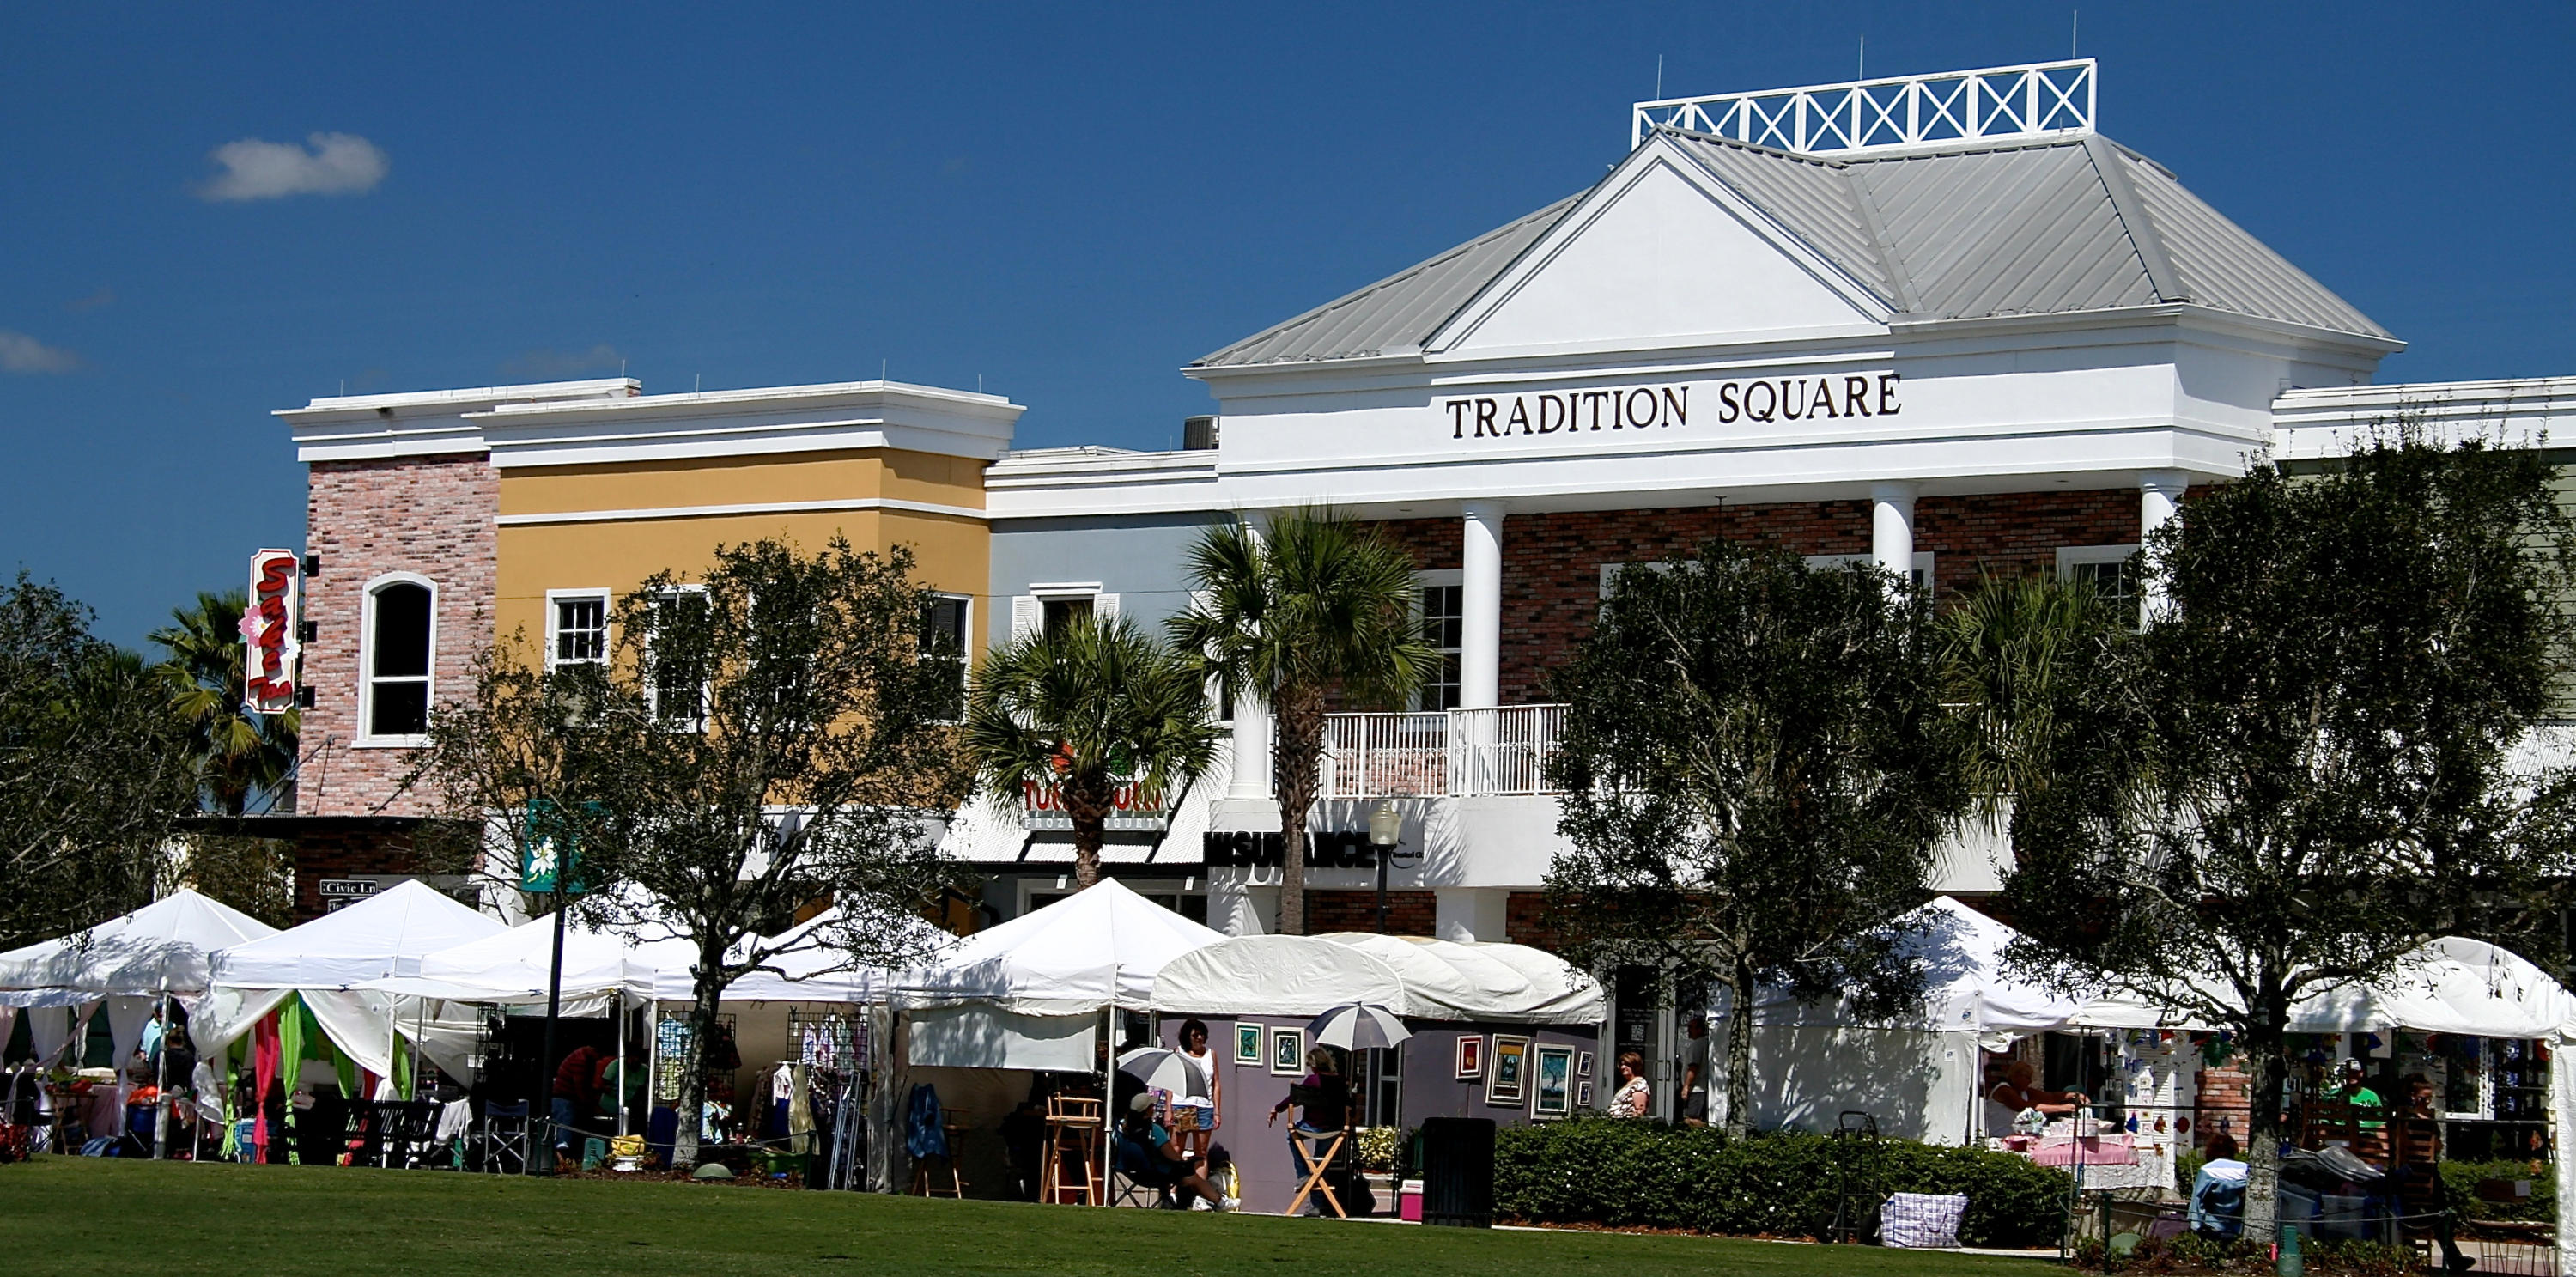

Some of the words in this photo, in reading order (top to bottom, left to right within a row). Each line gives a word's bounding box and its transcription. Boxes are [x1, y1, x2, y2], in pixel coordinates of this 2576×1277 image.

[1445, 386, 1688, 439] TRADITION
[1718, 374, 1902, 424] SQUARE
[257, 557, 296, 672] Sake
[1024, 818, 1074, 829] FROZE
[1103, 818, 1154, 829] OGURT
[326, 883, 356, 893] Civic
[361, 883, 376, 893] Ln
